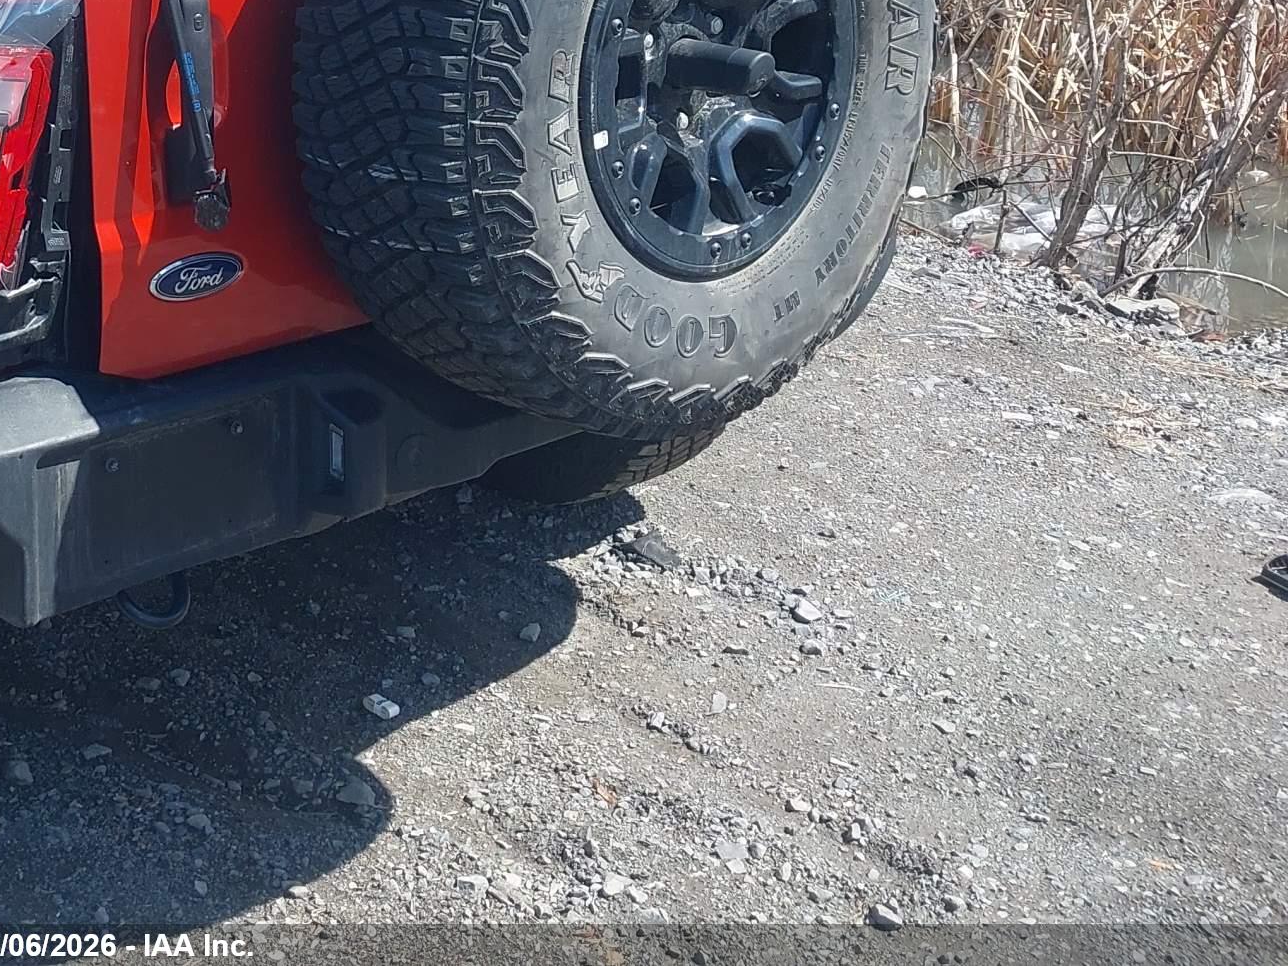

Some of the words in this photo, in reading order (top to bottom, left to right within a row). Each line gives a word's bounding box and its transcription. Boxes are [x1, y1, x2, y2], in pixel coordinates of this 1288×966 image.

[813, 142, 893, 287] TERRITORY
[174, 264, 224, 293] Ford
[773, 290, 801, 323] MT
